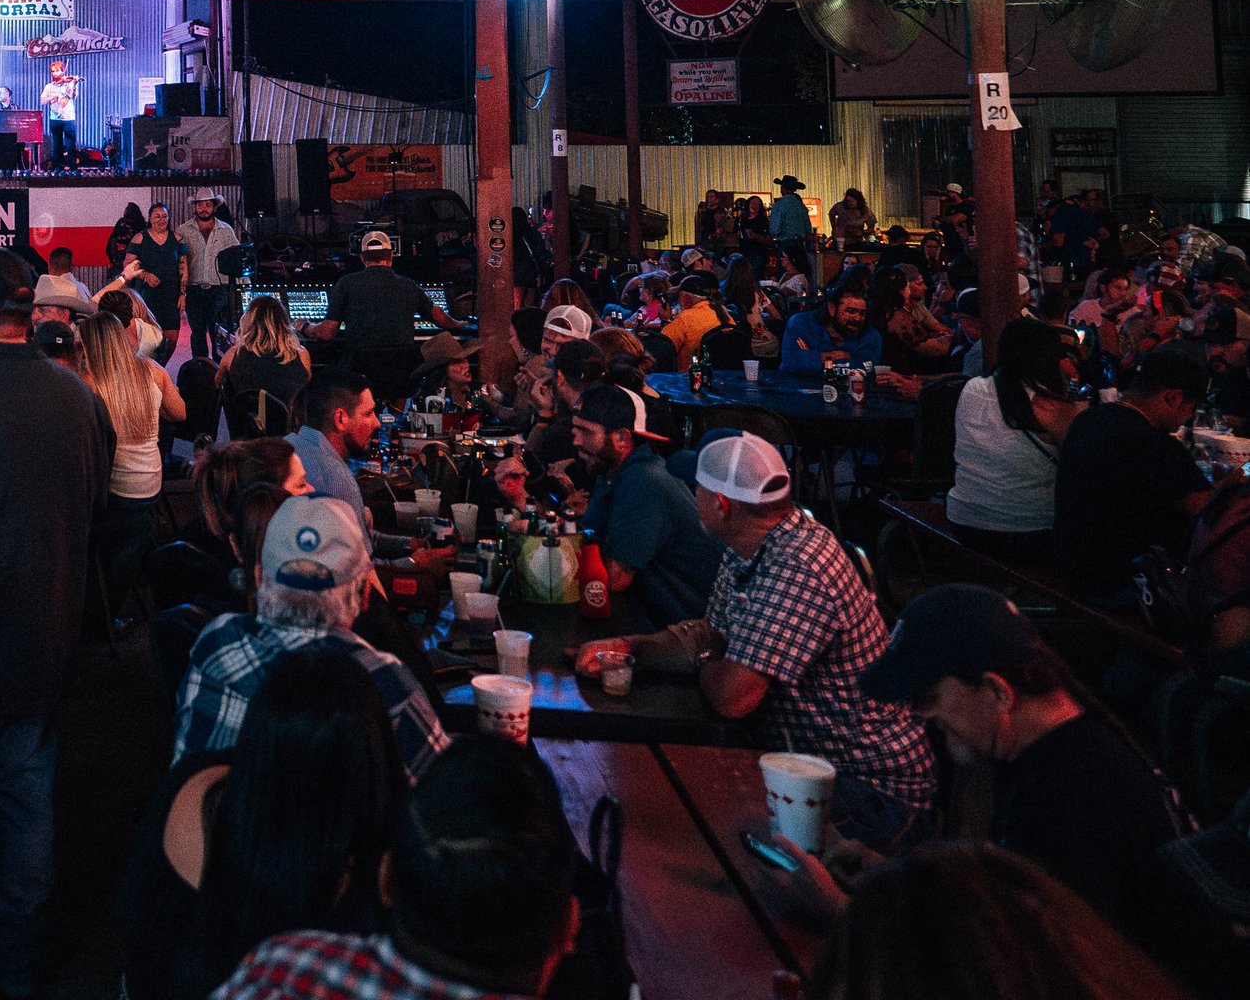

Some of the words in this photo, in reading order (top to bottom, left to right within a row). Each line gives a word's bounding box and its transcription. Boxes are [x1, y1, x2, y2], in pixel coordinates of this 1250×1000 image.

[27, 37, 76, 57] Coors
[76, 37, 124, 51] LIGHT
[690, 62, 713, 70] NOW
[674, 90, 735, 102] OPALINE
[986, 82, 1001, 98] R
[987, 105, 1008, 121] 20
[558, 144, 564, 152] 8
